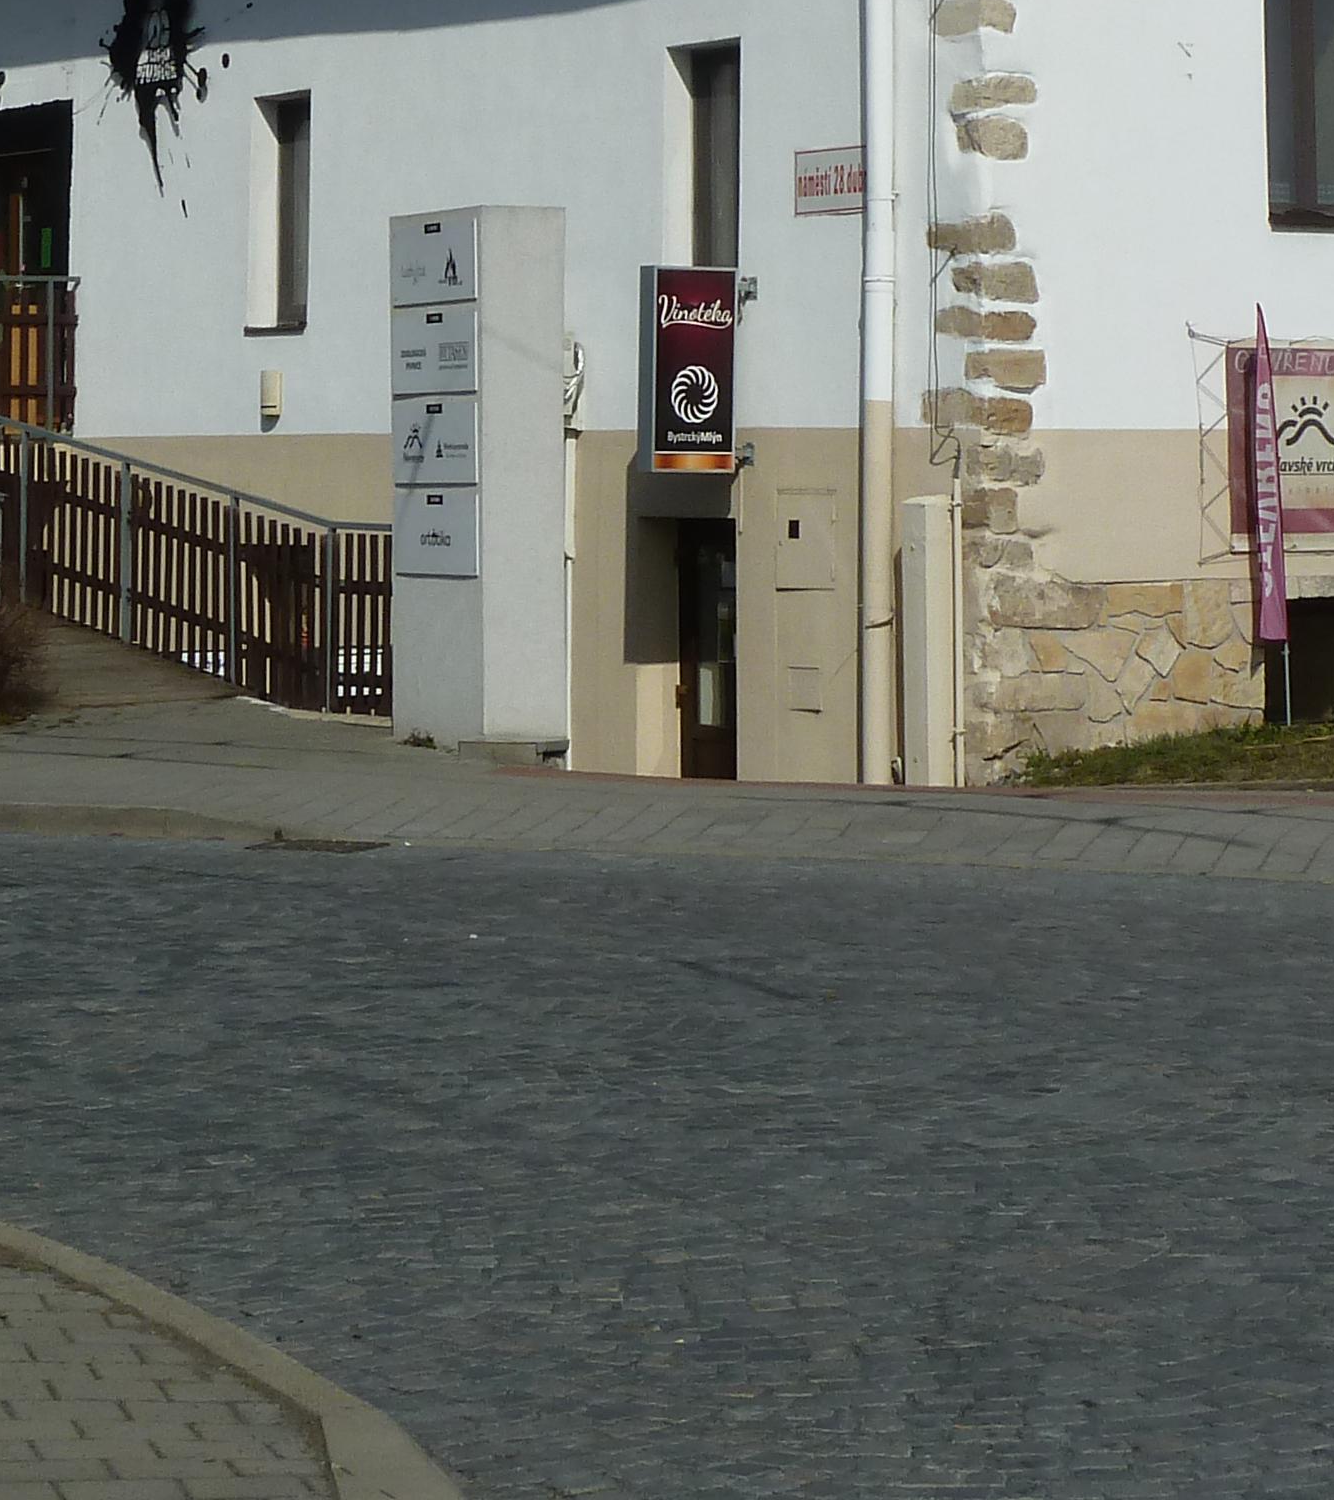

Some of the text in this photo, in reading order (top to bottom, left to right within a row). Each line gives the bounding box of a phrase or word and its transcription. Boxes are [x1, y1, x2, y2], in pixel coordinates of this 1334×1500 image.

[797, 165, 831, 197] náměstí
[658, 294, 733, 329] Vinotéka
[1278, 456, 1313, 476] avské
